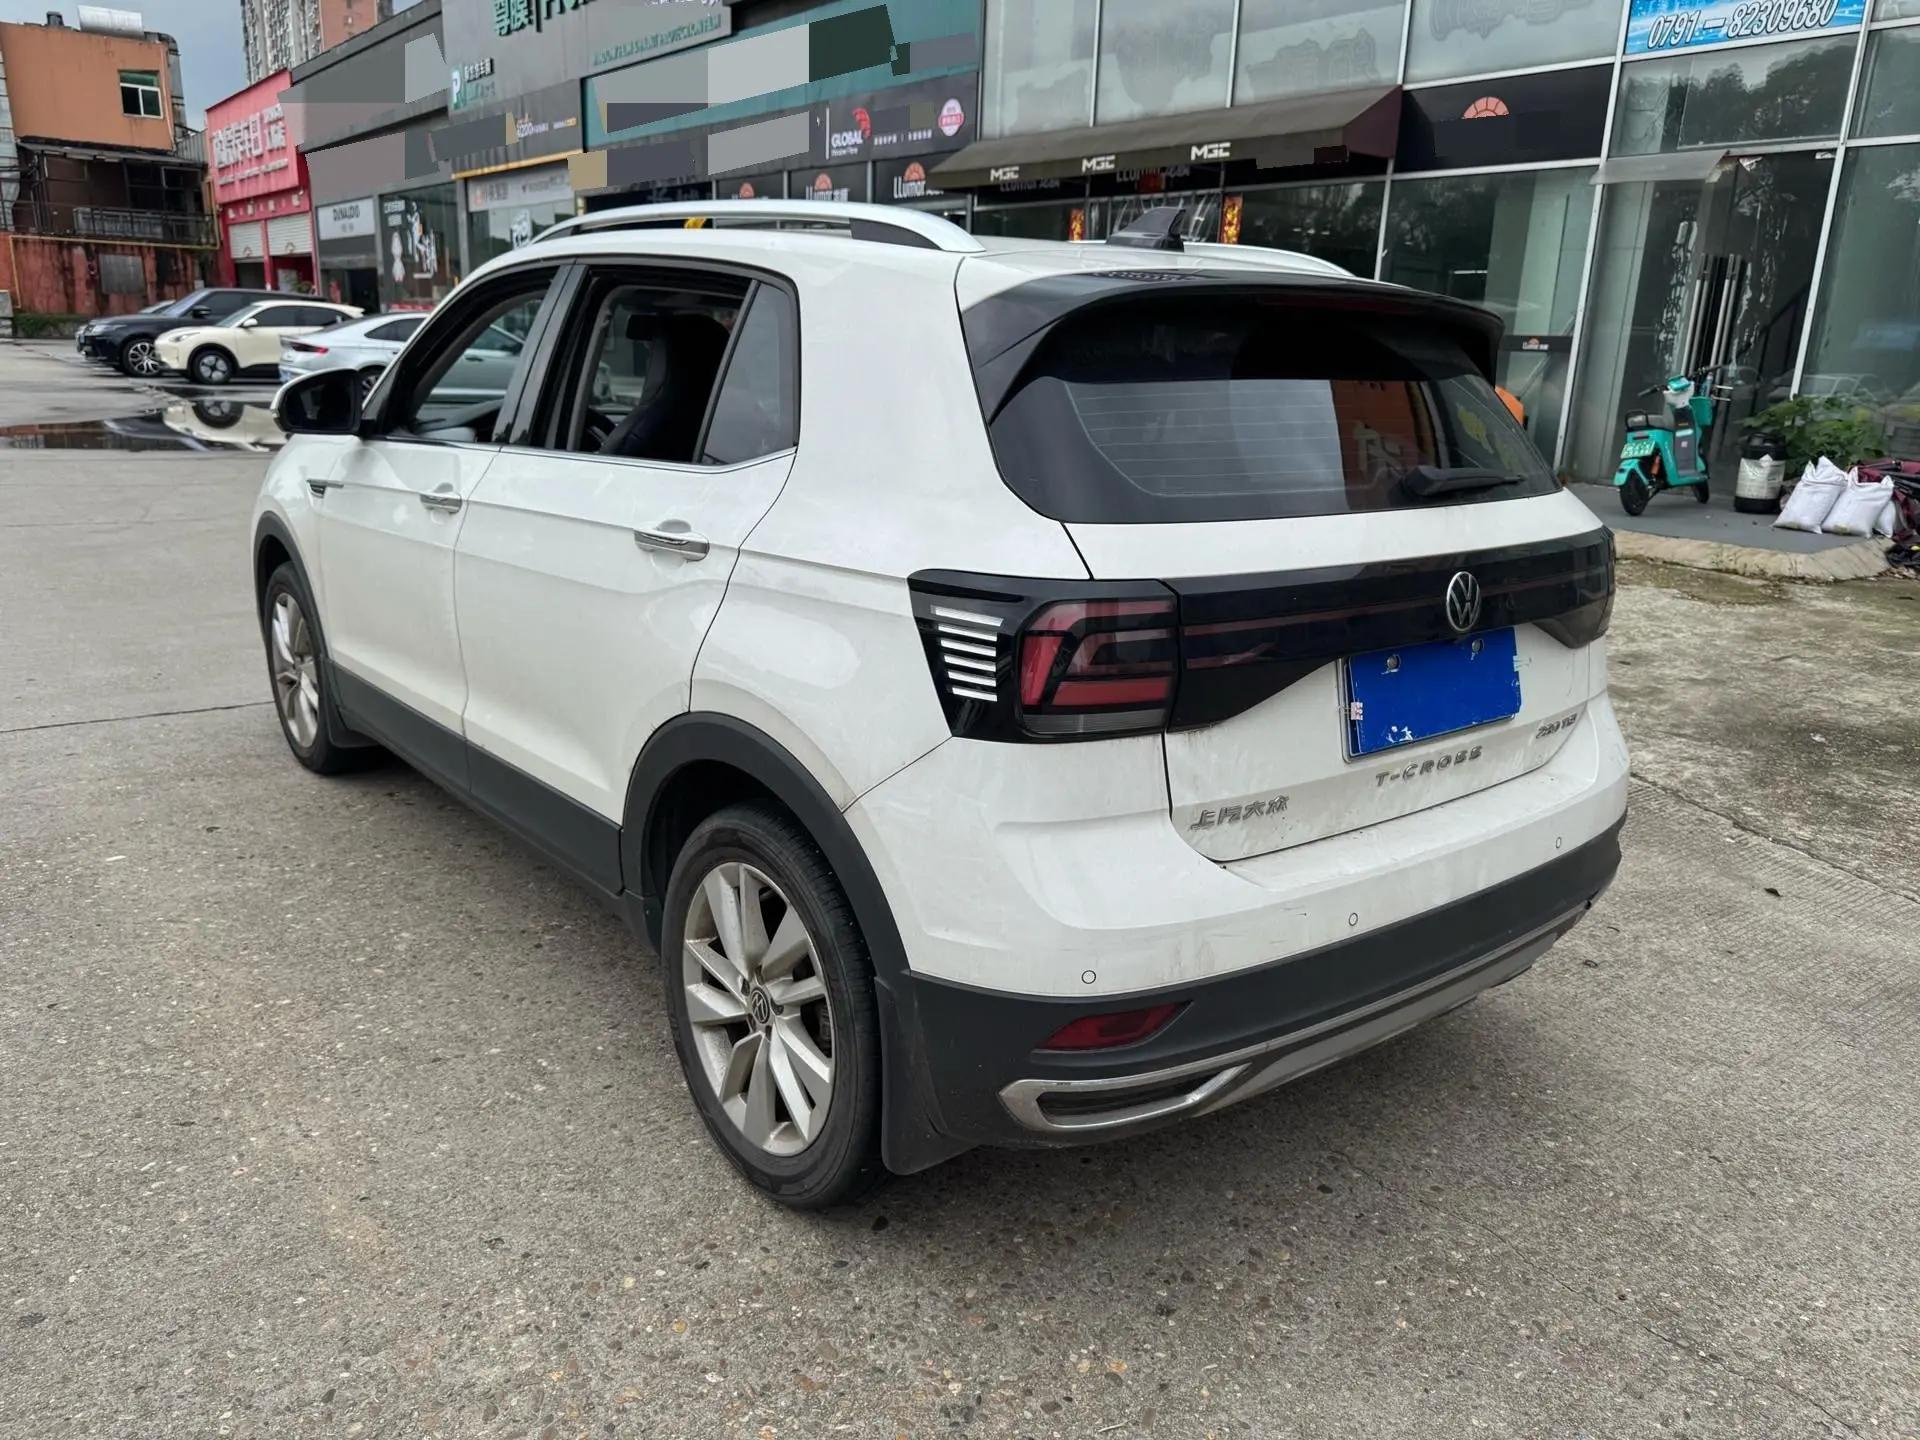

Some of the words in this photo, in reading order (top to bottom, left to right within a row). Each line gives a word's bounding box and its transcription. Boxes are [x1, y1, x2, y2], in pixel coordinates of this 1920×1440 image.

[831, 130, 863, 147] GLOBAL
[1375, 746, 1483, 787] T-CROSS
[1189, 794, 1290, 832] 上汽大众
